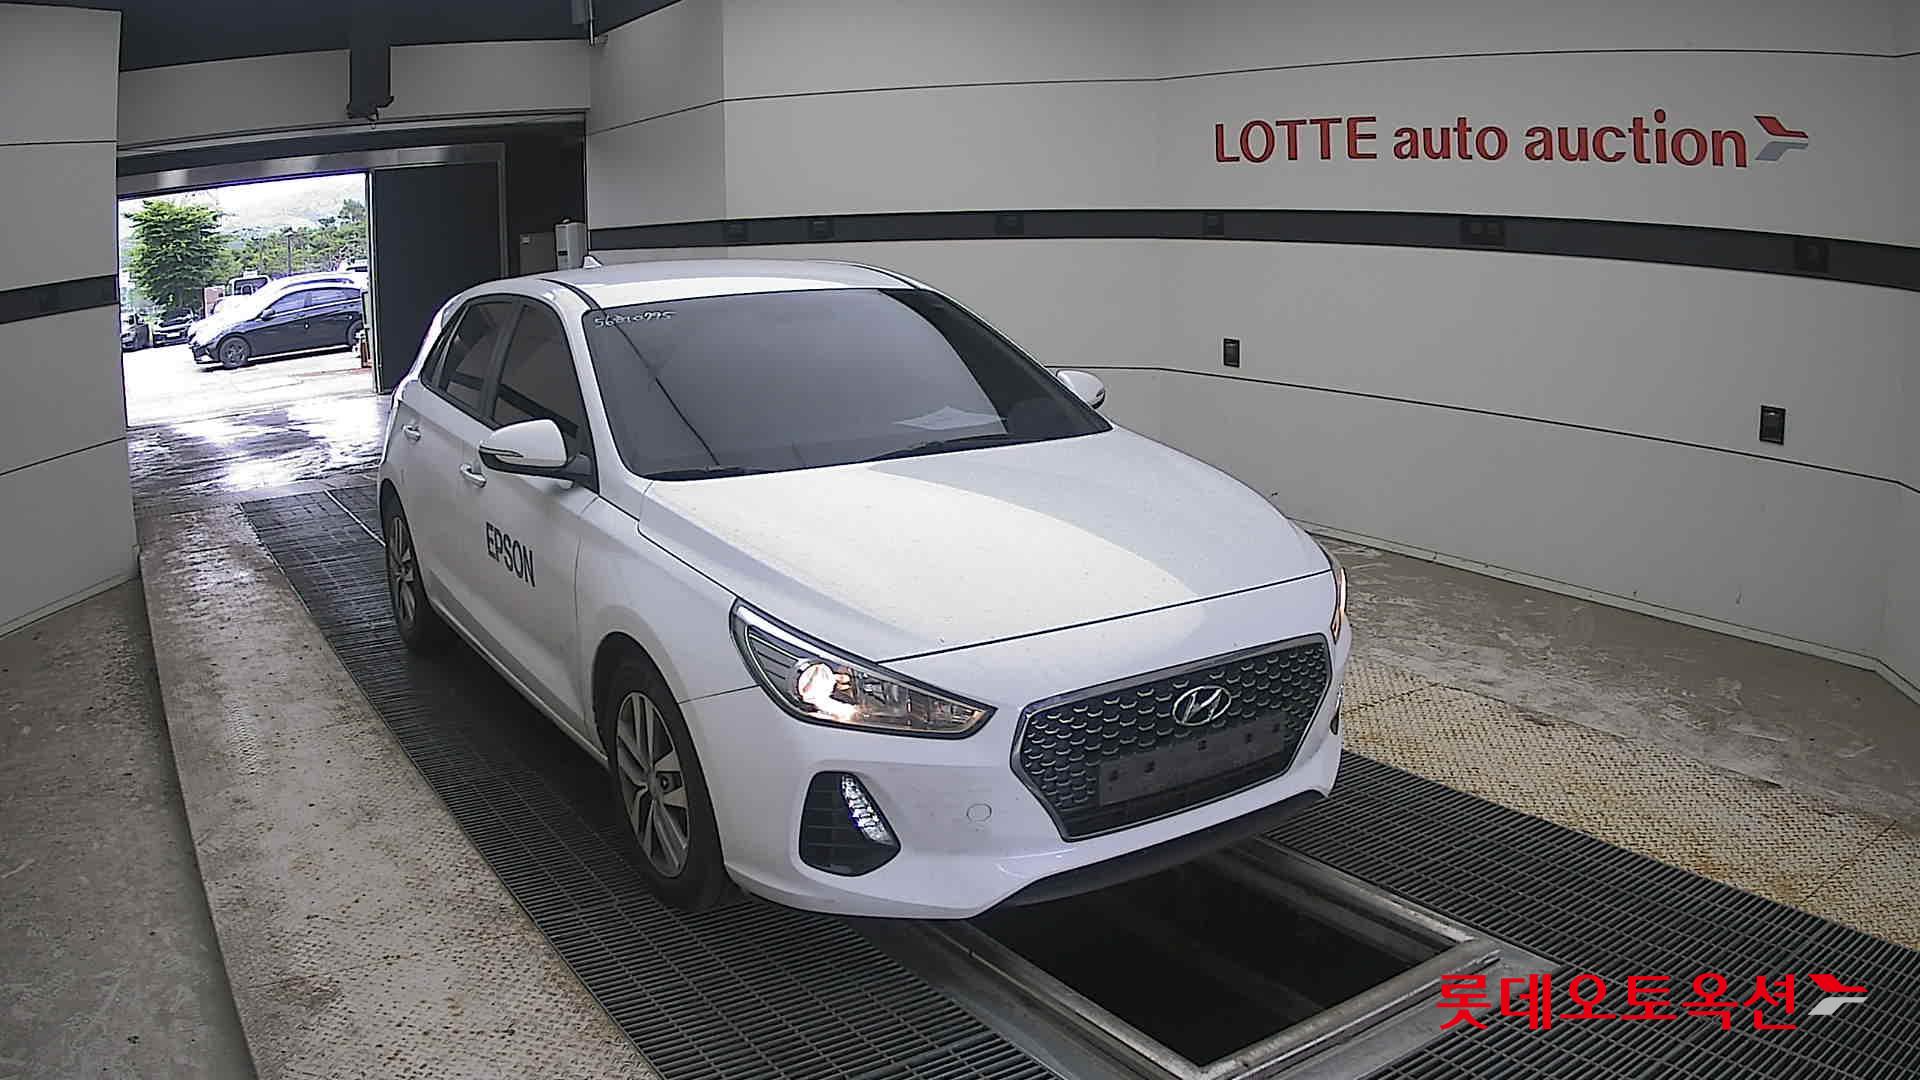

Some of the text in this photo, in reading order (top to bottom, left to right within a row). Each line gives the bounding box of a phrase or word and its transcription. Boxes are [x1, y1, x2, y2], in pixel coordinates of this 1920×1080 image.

[1215, 109, 1747, 168] LOTTE auto auction
[486, 521, 536, 588] EPSON
